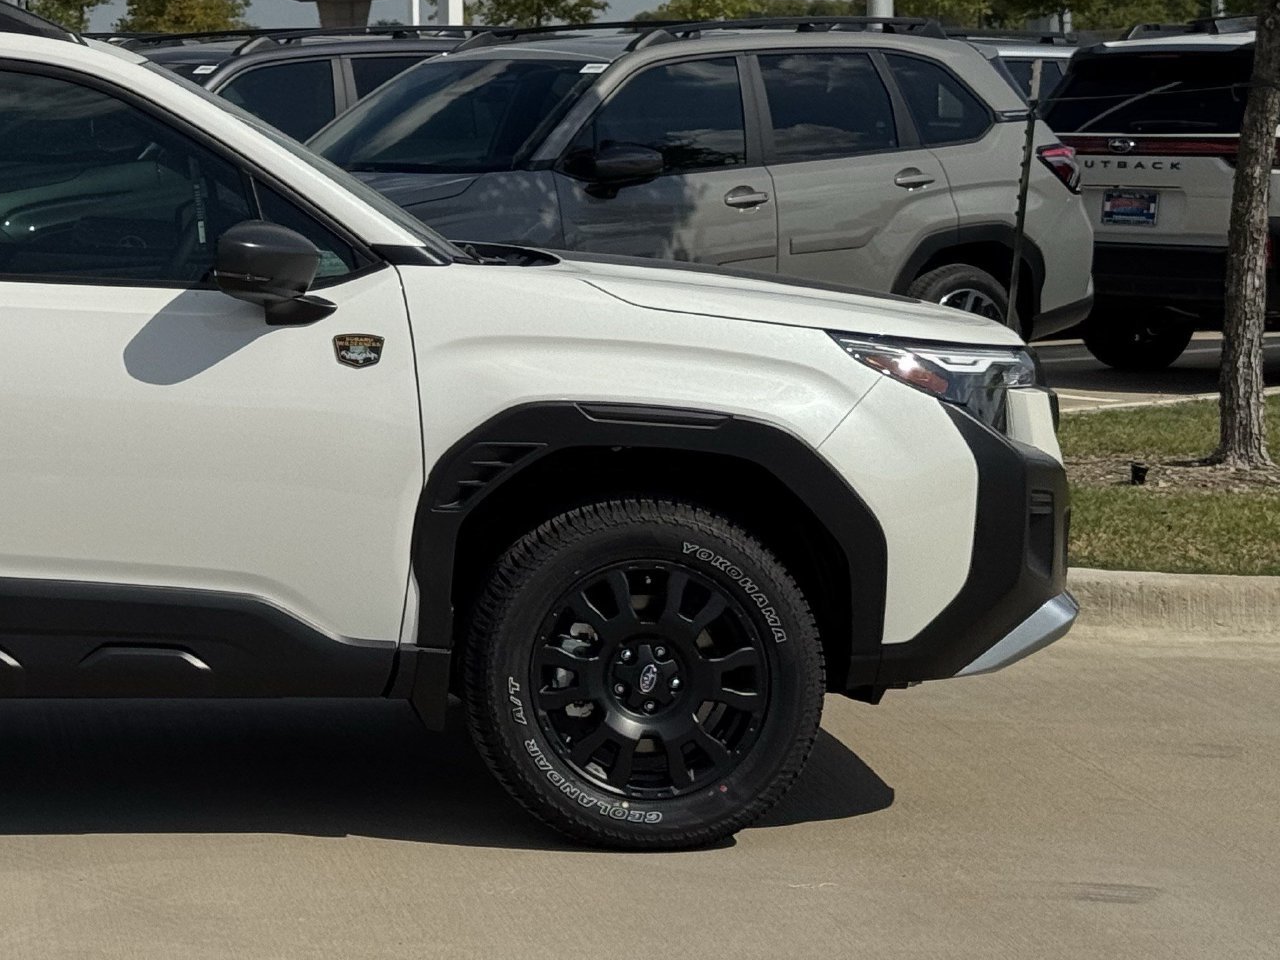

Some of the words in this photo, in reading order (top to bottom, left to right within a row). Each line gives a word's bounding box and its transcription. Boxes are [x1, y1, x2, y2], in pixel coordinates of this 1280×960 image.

[1083, 160, 1182, 171] UTBACK
[682, 541, 787, 643] YOKOHAMA
[507, 675, 528, 726] A/T
[523, 738, 663, 825] GEOLANDAR
